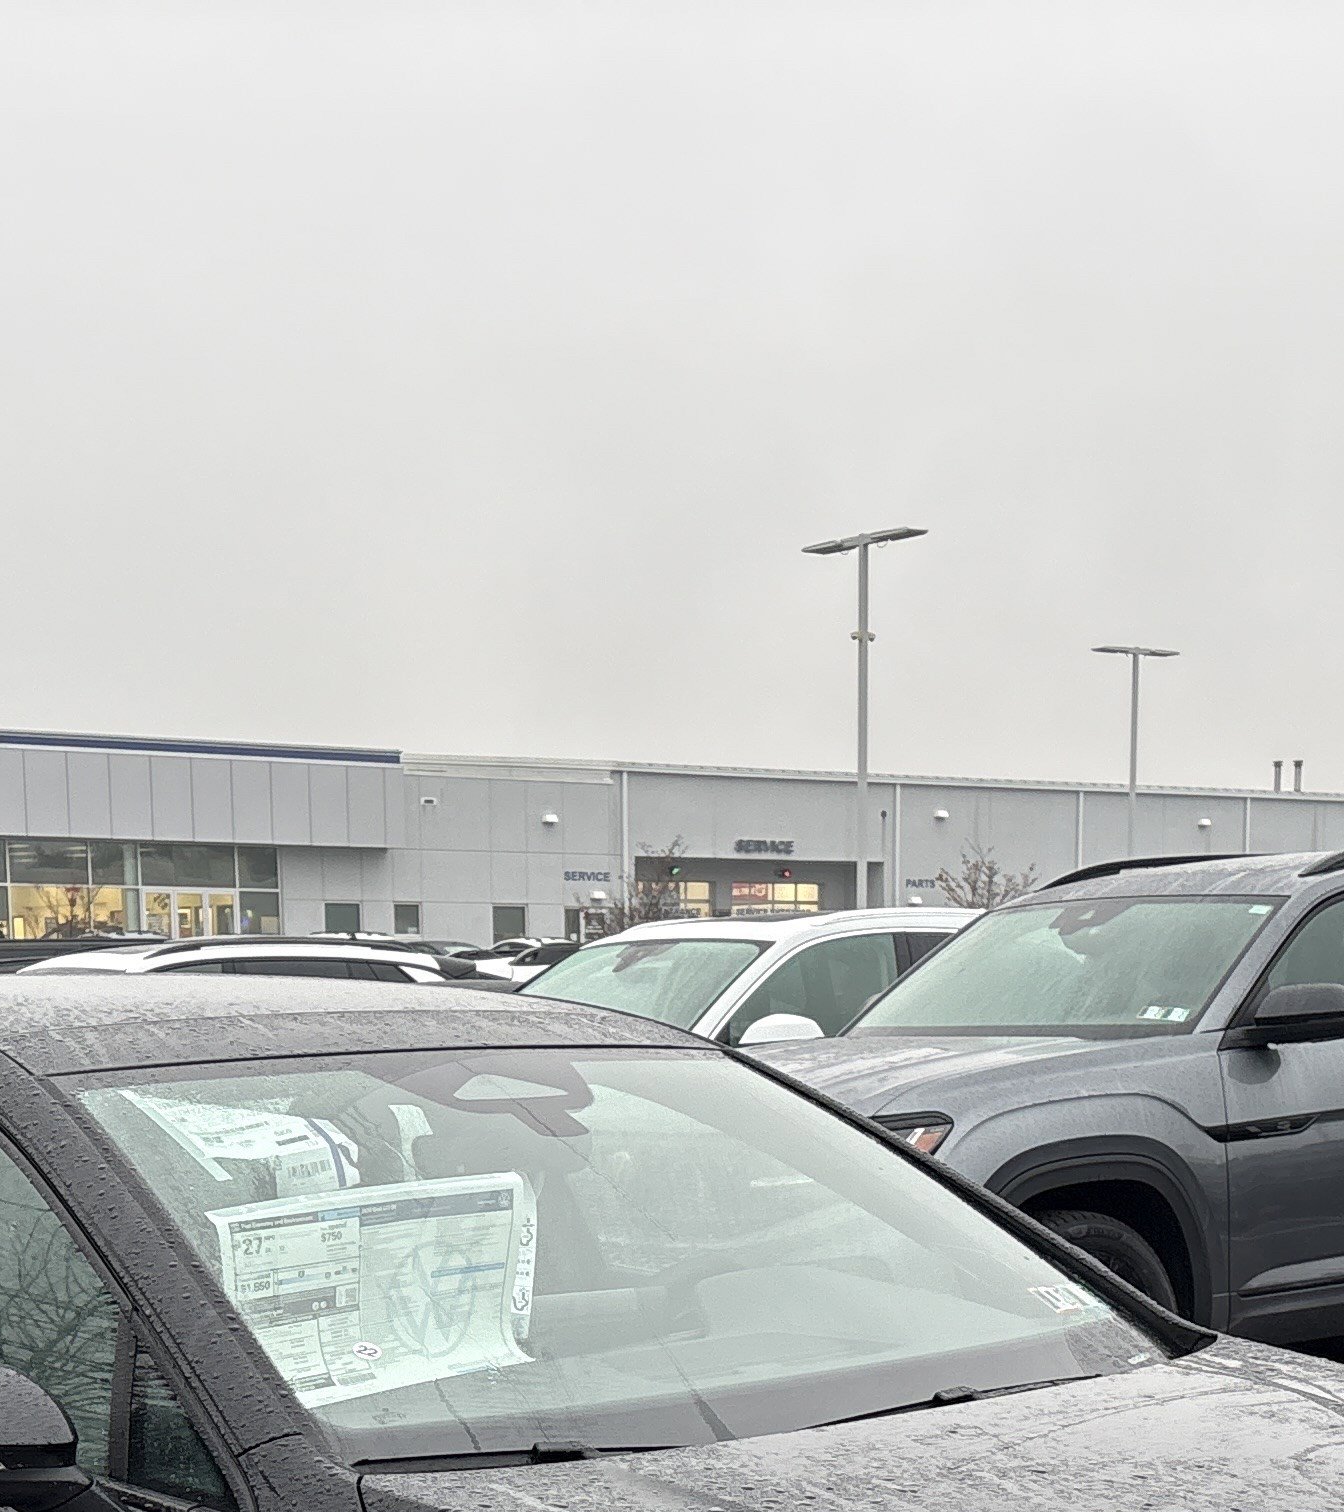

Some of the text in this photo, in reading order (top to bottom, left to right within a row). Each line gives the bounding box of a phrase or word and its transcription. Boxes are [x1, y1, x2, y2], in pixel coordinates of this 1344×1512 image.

[734, 838, 795, 854] SERVICE
[563, 870, 611, 883] SERVICE
[905, 878, 936, 889] PARTS
[242, 1236, 263, 1256] 27
[356, 1344, 378, 1358] 22
